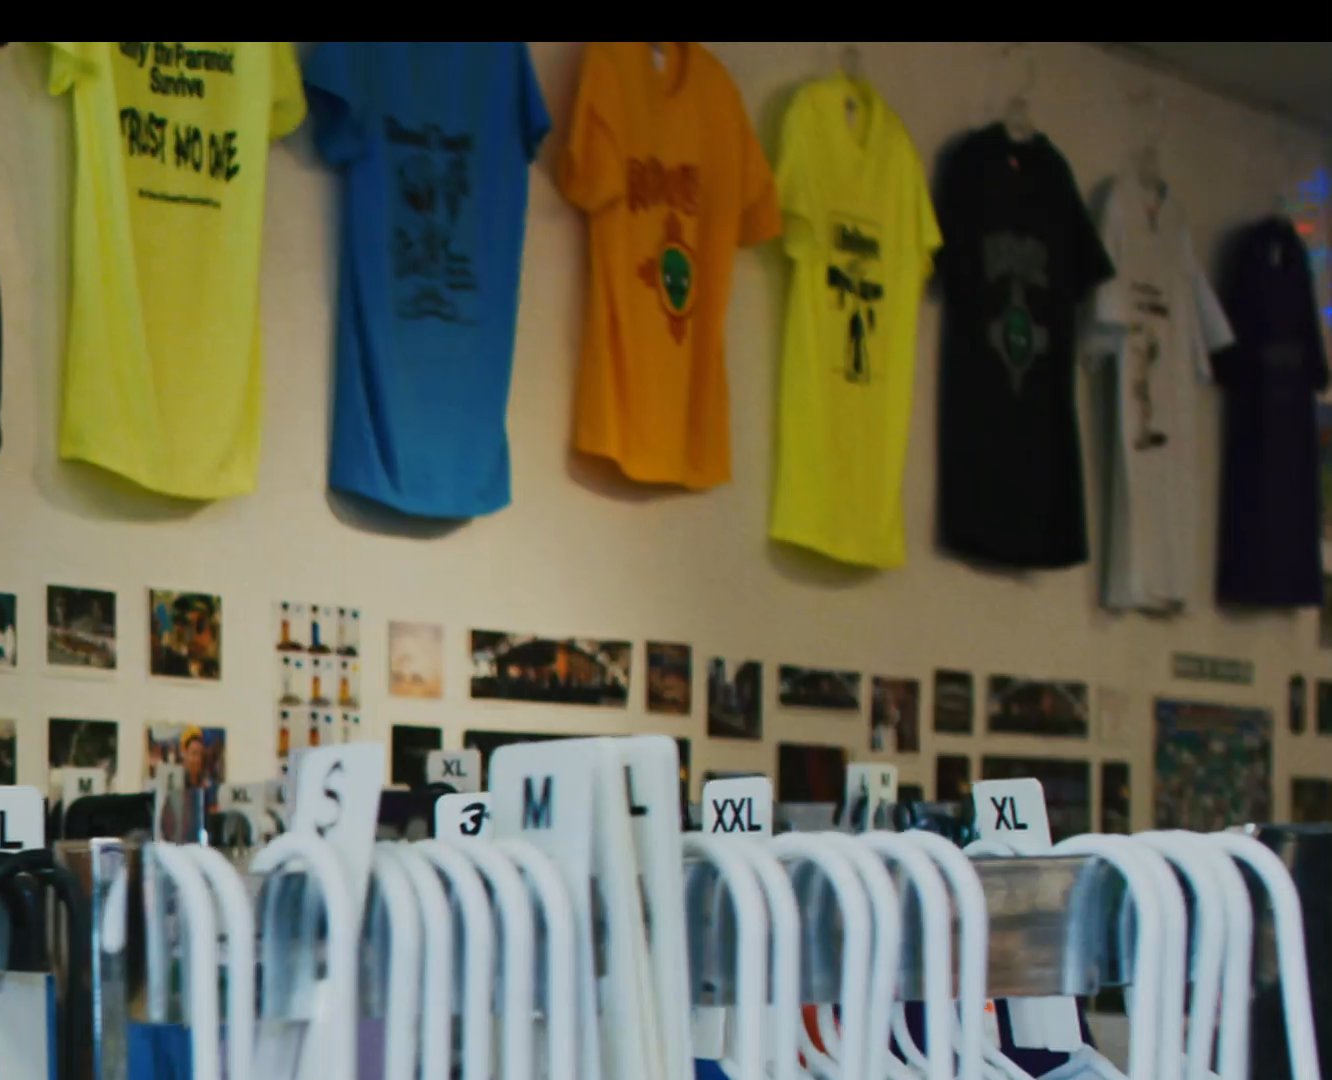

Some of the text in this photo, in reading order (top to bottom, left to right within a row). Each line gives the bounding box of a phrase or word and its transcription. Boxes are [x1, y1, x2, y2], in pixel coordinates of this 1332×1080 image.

[174, 123, 204, 173] NO
[442, 759, 467, 777] XL
[522, 765, 648, 829] M L
[712, 797, 762, 833] XXL
[990, 796, 1028, 830] XL
